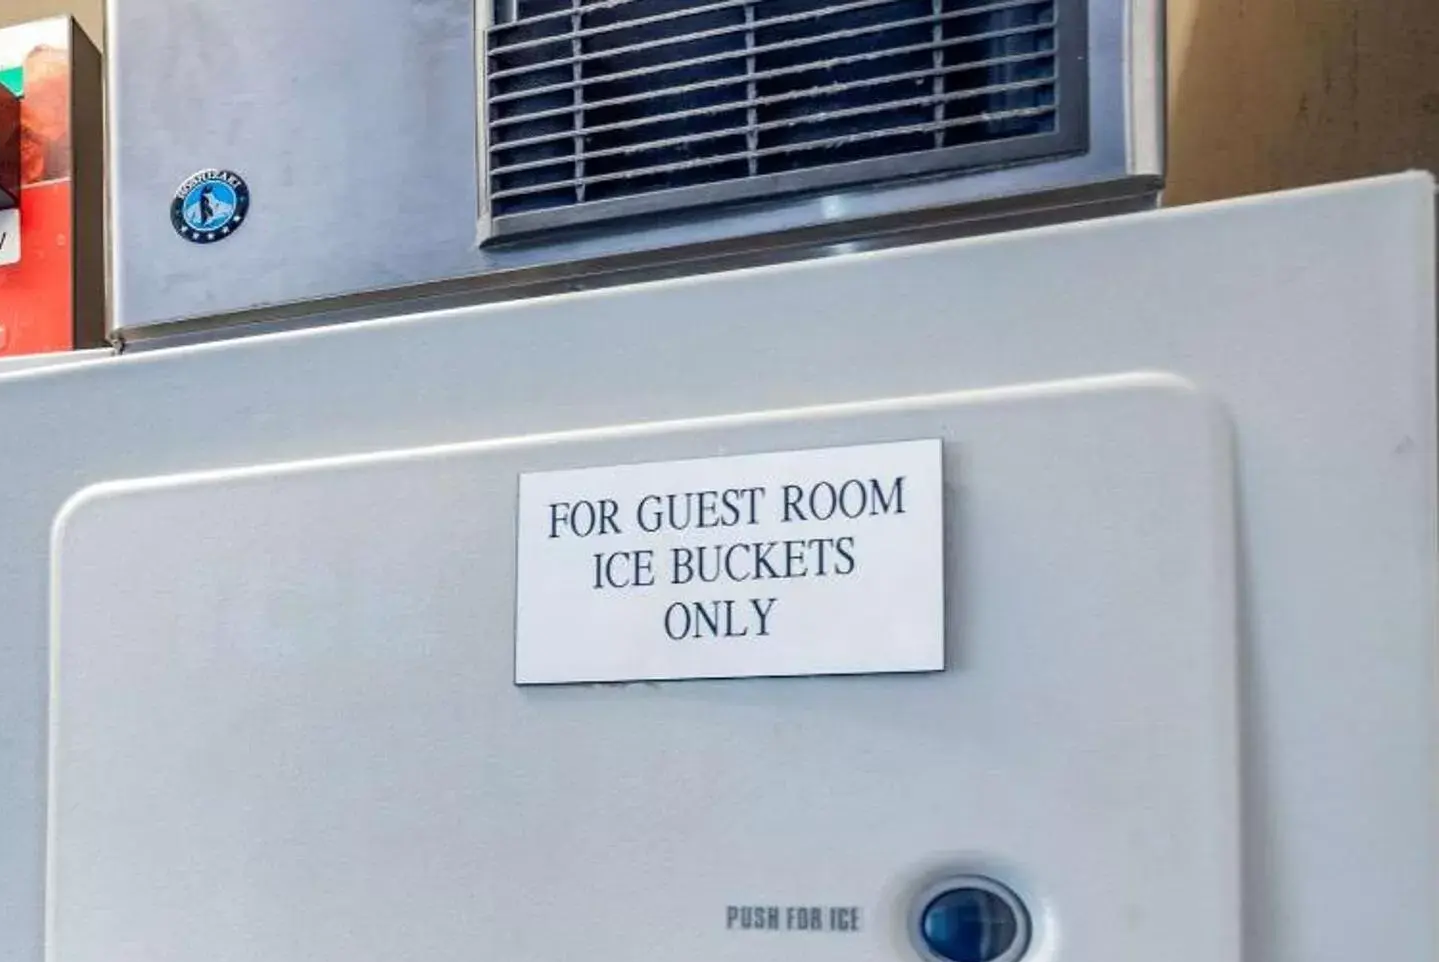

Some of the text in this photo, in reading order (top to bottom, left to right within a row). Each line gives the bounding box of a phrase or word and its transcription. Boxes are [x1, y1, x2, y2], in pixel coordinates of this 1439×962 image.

[549, 475, 907, 539] FOR GUEST ROOM
[592, 536, 856, 589] ICE BUCKETS
[664, 598, 778, 641] ONLY
[725, 905, 859, 932] PUSH FOR ICE
